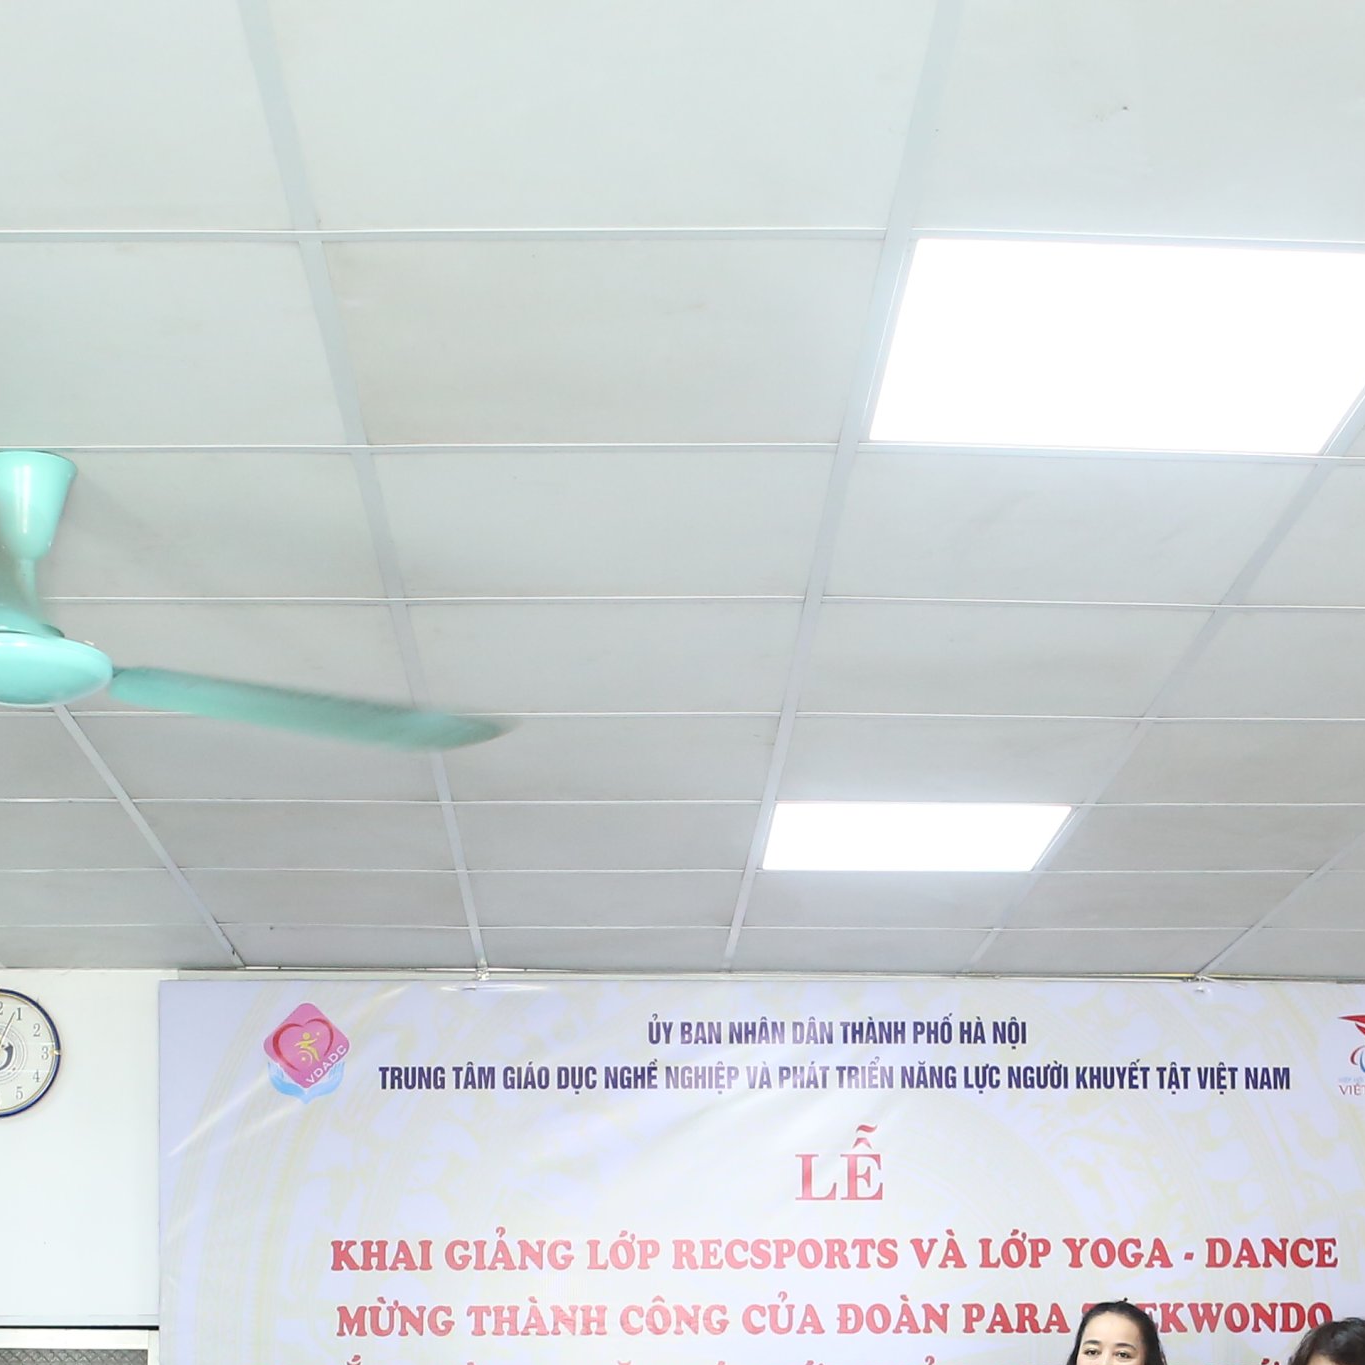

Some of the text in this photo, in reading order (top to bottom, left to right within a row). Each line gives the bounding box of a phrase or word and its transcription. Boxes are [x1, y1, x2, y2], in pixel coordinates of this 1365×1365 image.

[16, 1007, 22, 1021] 1
[33, 1023, 41, 1037] 2
[647, 1011, 1027, 1050] ỦY BAN NHÂN DÂN THÀNH PHỐ HÀ NỘI
[41, 1046, 49, 1060] 3
[306, 1045, 347, 1083] VDADC
[16, 1086, 23, 1100] 5
[33, 1070, 40, 1083] 4
[378, 1057, 1291, 1096] TRUNG TÂM GIÁO DỤC NGHỀ NGHIỆP VÀ PHÁT TRIỂN NĂNG LỰC NGƯỜI KHUYẾT TẬT VIỆT NAM
[795, 1124, 884, 1201] LỄ
[331, 1239, 433, 1271] KHAI
[445, 1226, 574, 1271] GIẢNG
[588, 1231, 660, 1270] LỚP
[673, 1238, 899, 1270] RECSPORTS
[911, 1229, 967, 1269] VÀ
[979, 1229, 1052, 1269] LỚP
[1062, 1238, 1173, 1270] YOGA
[1206, 1238, 1339, 1270] DANCE
[337, 1297, 454, 1337] MỪNG
[468, 1297, 607, 1336] THÀNH
[621, 1295, 728, 1336] CÔNG
[742, 1292, 824, 1335] CỦA
[838, 1295, 950, 1335] ĐOÀN
[963, 1302, 1071, 1335] PARA
